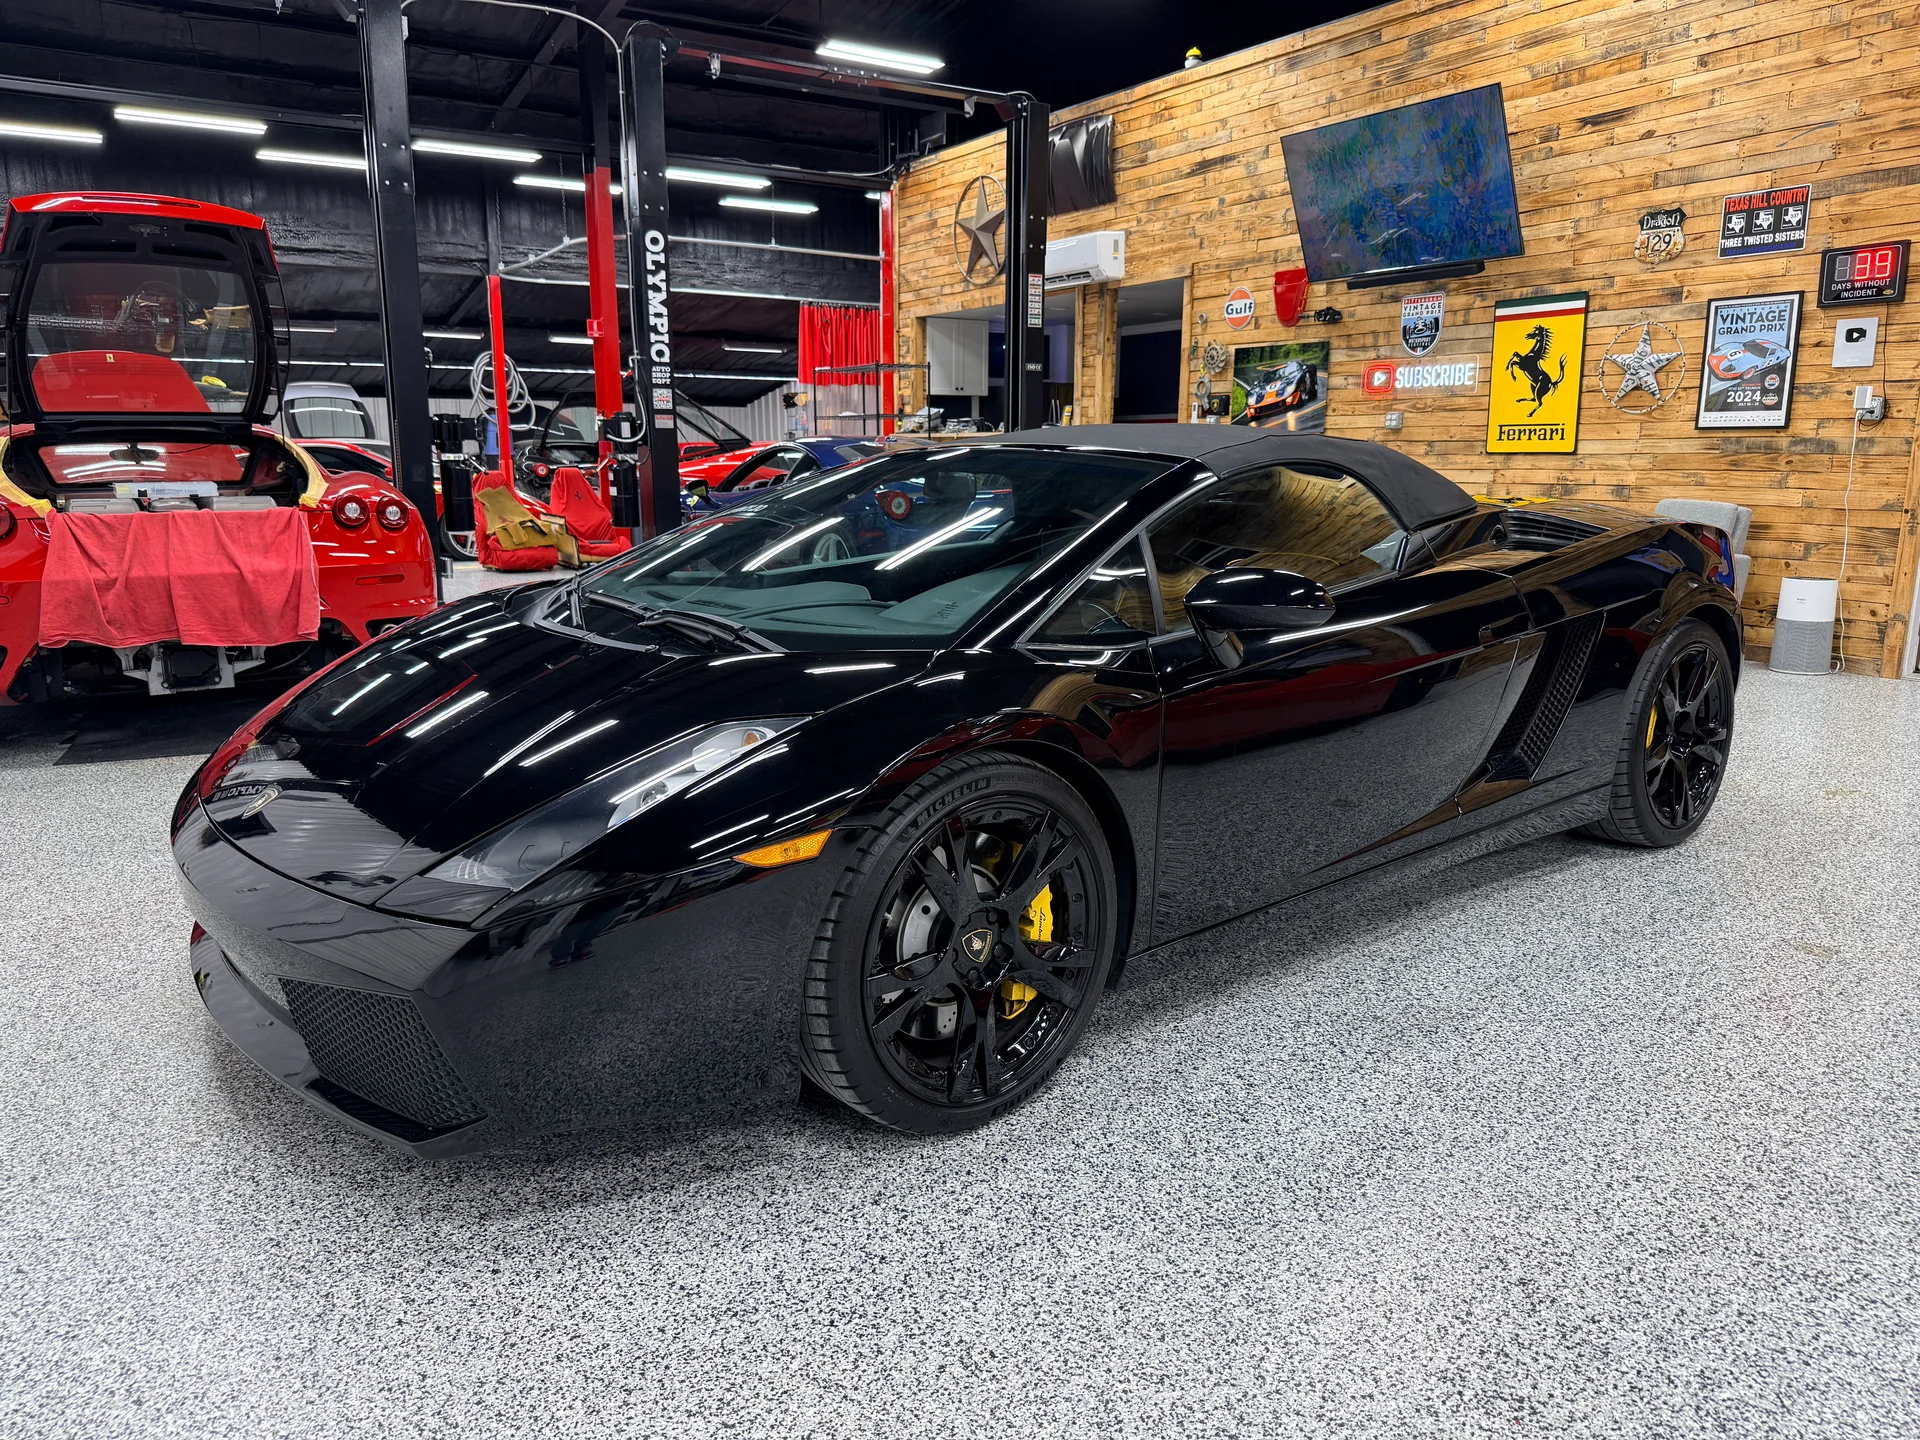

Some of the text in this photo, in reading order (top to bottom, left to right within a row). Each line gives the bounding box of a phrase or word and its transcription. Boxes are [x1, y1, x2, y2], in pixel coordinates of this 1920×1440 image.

[1725, 187, 1809, 213] TEXAS HILL COUNTRY
[1643, 212, 1680, 230] Dragon
[1645, 233, 1672, 253] 129
[1720, 229, 1805, 249] THREE TWISTED SISTERS
[1831, 278, 1891, 291] DAYS WITHOUT
[644, 230, 670, 363] OLYMPIC
[1405, 296, 1442, 304] PITTSBURGH
[1840, 288, 1877, 299] INCIDENT
[1225, 301, 1254, 316] Gulf
[1403, 302, 1442, 311] VINTAGE
[1719, 309, 1788, 326] VINTAGE
[1718, 322, 1786, 336] GRAND PRIX
[1394, 362, 1476, 389] SUBSCRIBE
[1726, 390, 1761, 403] 2024
[1496, 423, 1566, 442] Ferrari
[916, 777, 990, 826] MICHELIN
